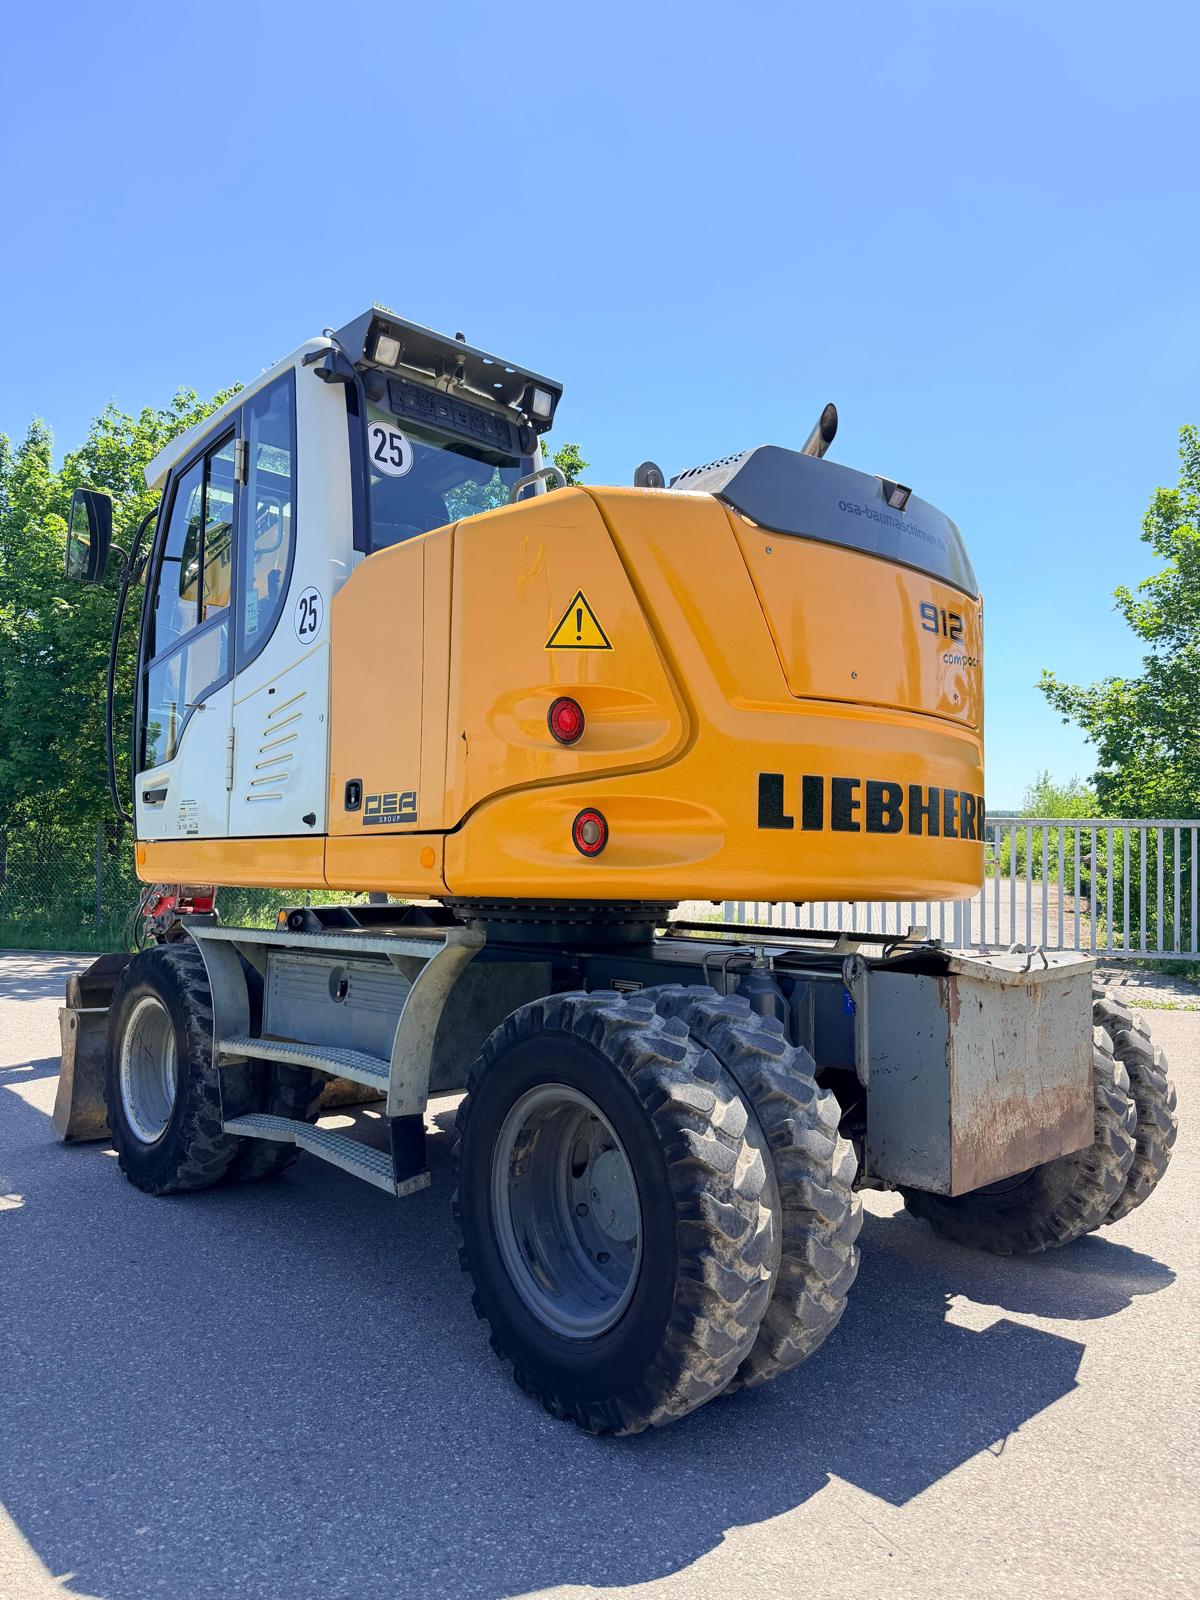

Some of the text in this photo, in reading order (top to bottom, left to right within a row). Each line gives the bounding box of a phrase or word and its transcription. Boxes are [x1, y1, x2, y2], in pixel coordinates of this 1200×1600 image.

[373, 427, 404, 468] 25
[299, 594, 318, 635] 25
[919, 600, 964, 645] 912
[379, 815, 401, 823] GROUP
[757, 772, 986, 843] LIEBHERR
